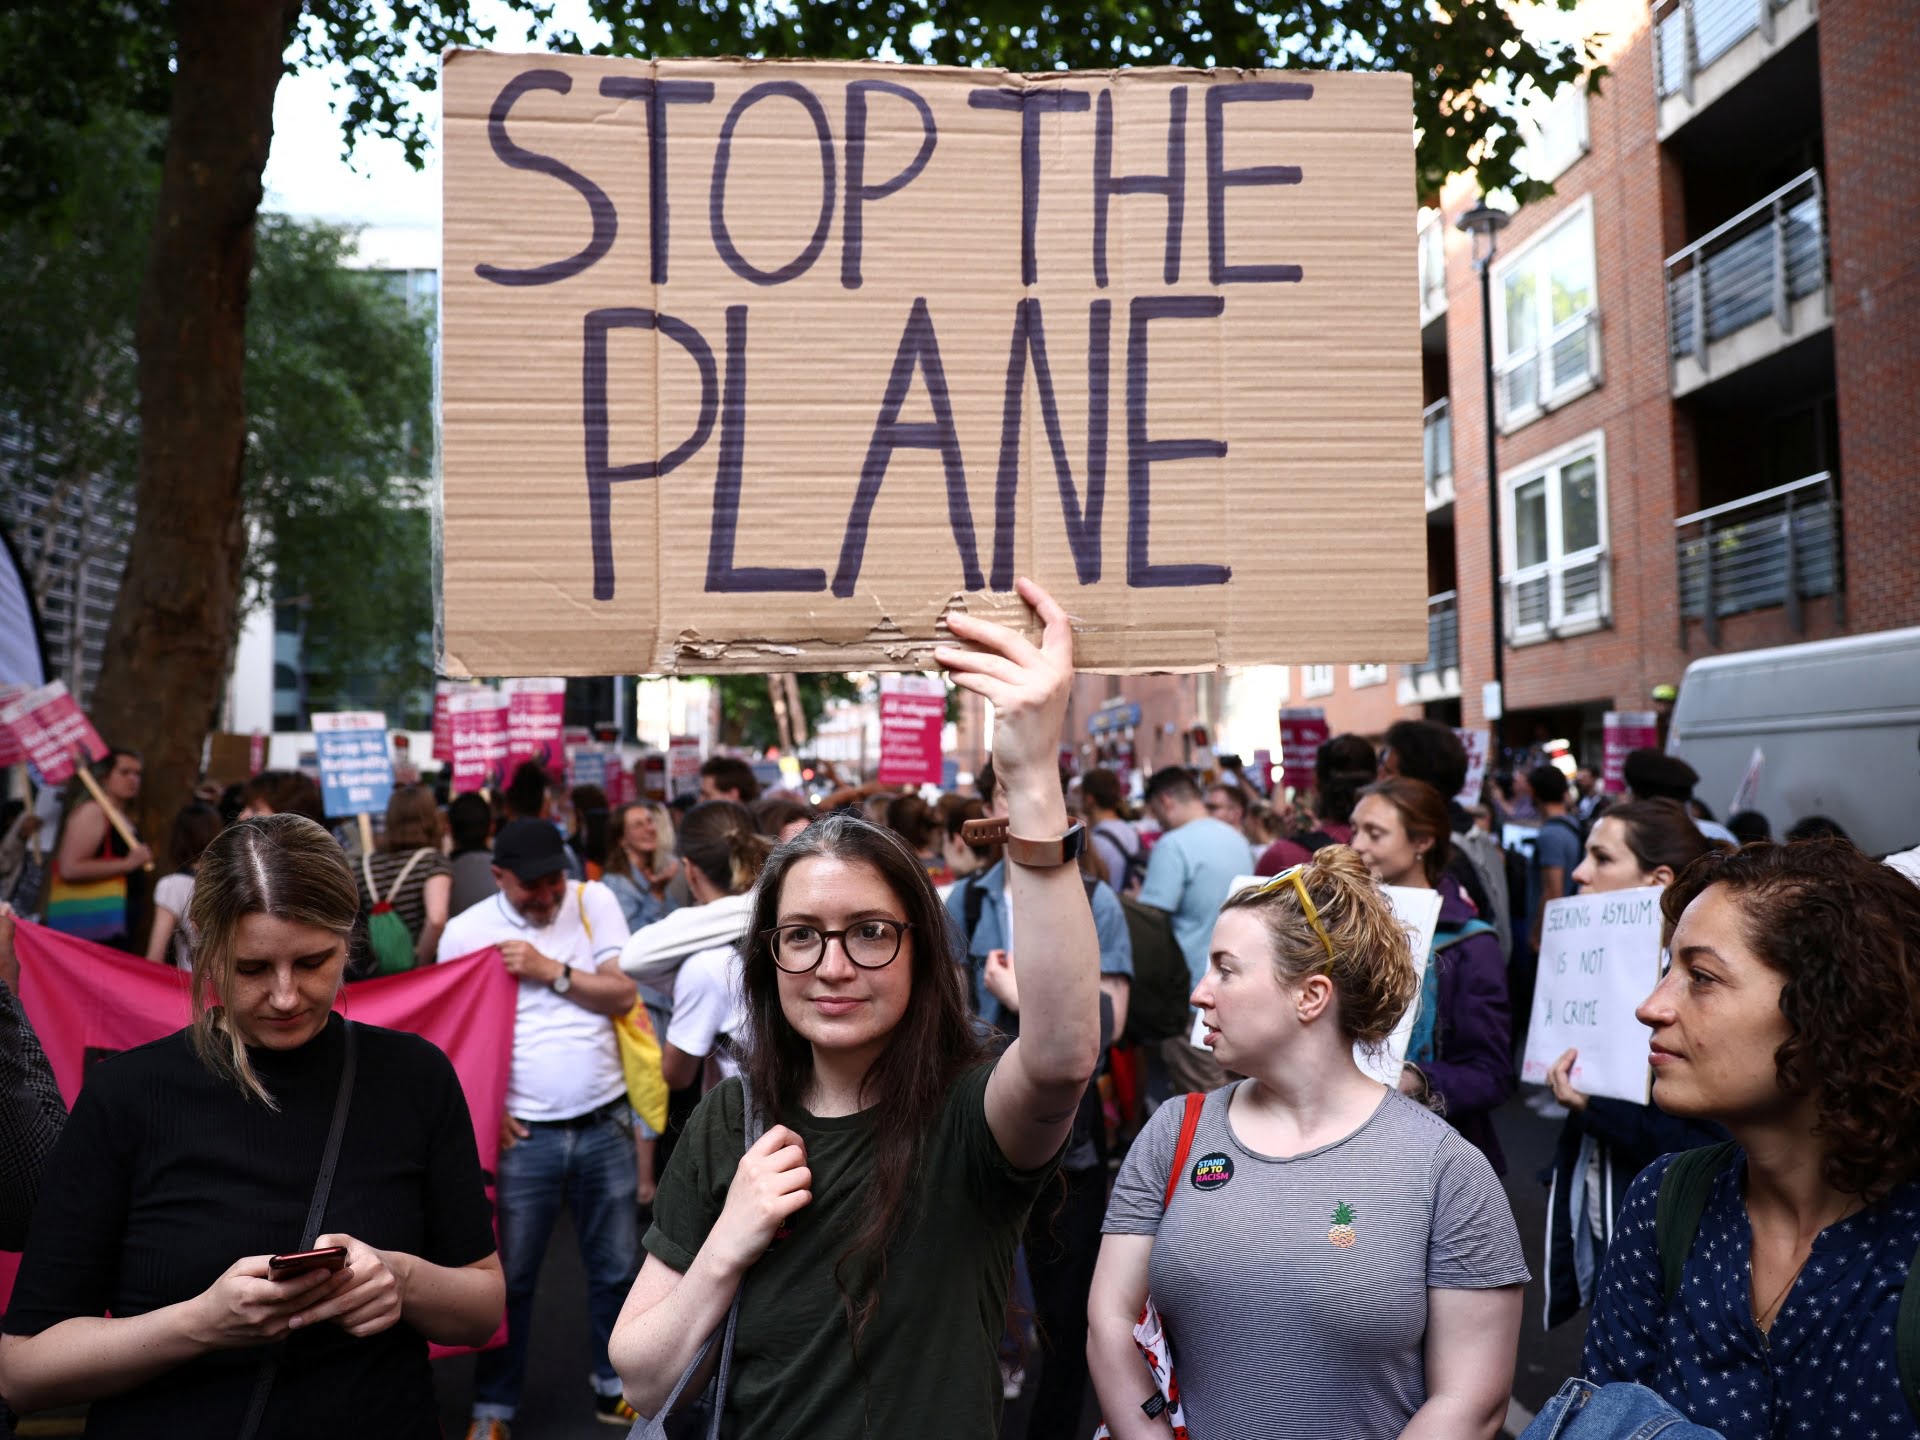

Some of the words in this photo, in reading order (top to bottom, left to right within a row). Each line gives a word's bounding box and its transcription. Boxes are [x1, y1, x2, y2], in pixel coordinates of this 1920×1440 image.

[474, 69, 938, 289] STOP
[968, 82, 1314, 287] THE
[582, 296, 1232, 599] PLANE
[1548, 905, 1590, 931] SEEKING
[1602, 899, 1652, 927] ASYLUM
[1556, 951, 1567, 975] IS
[1579, 948, 1605, 976] NOT
[1543, 1000, 1553, 1026] A
[1562, 999, 1600, 1027] CRIME
[1196, 1172, 1229, 1182] RACISM
[1197, 1167, 1209, 1175] UP
[1210, 1165, 1223, 1174] TO
[1198, 1158, 1226, 1168] STAND
